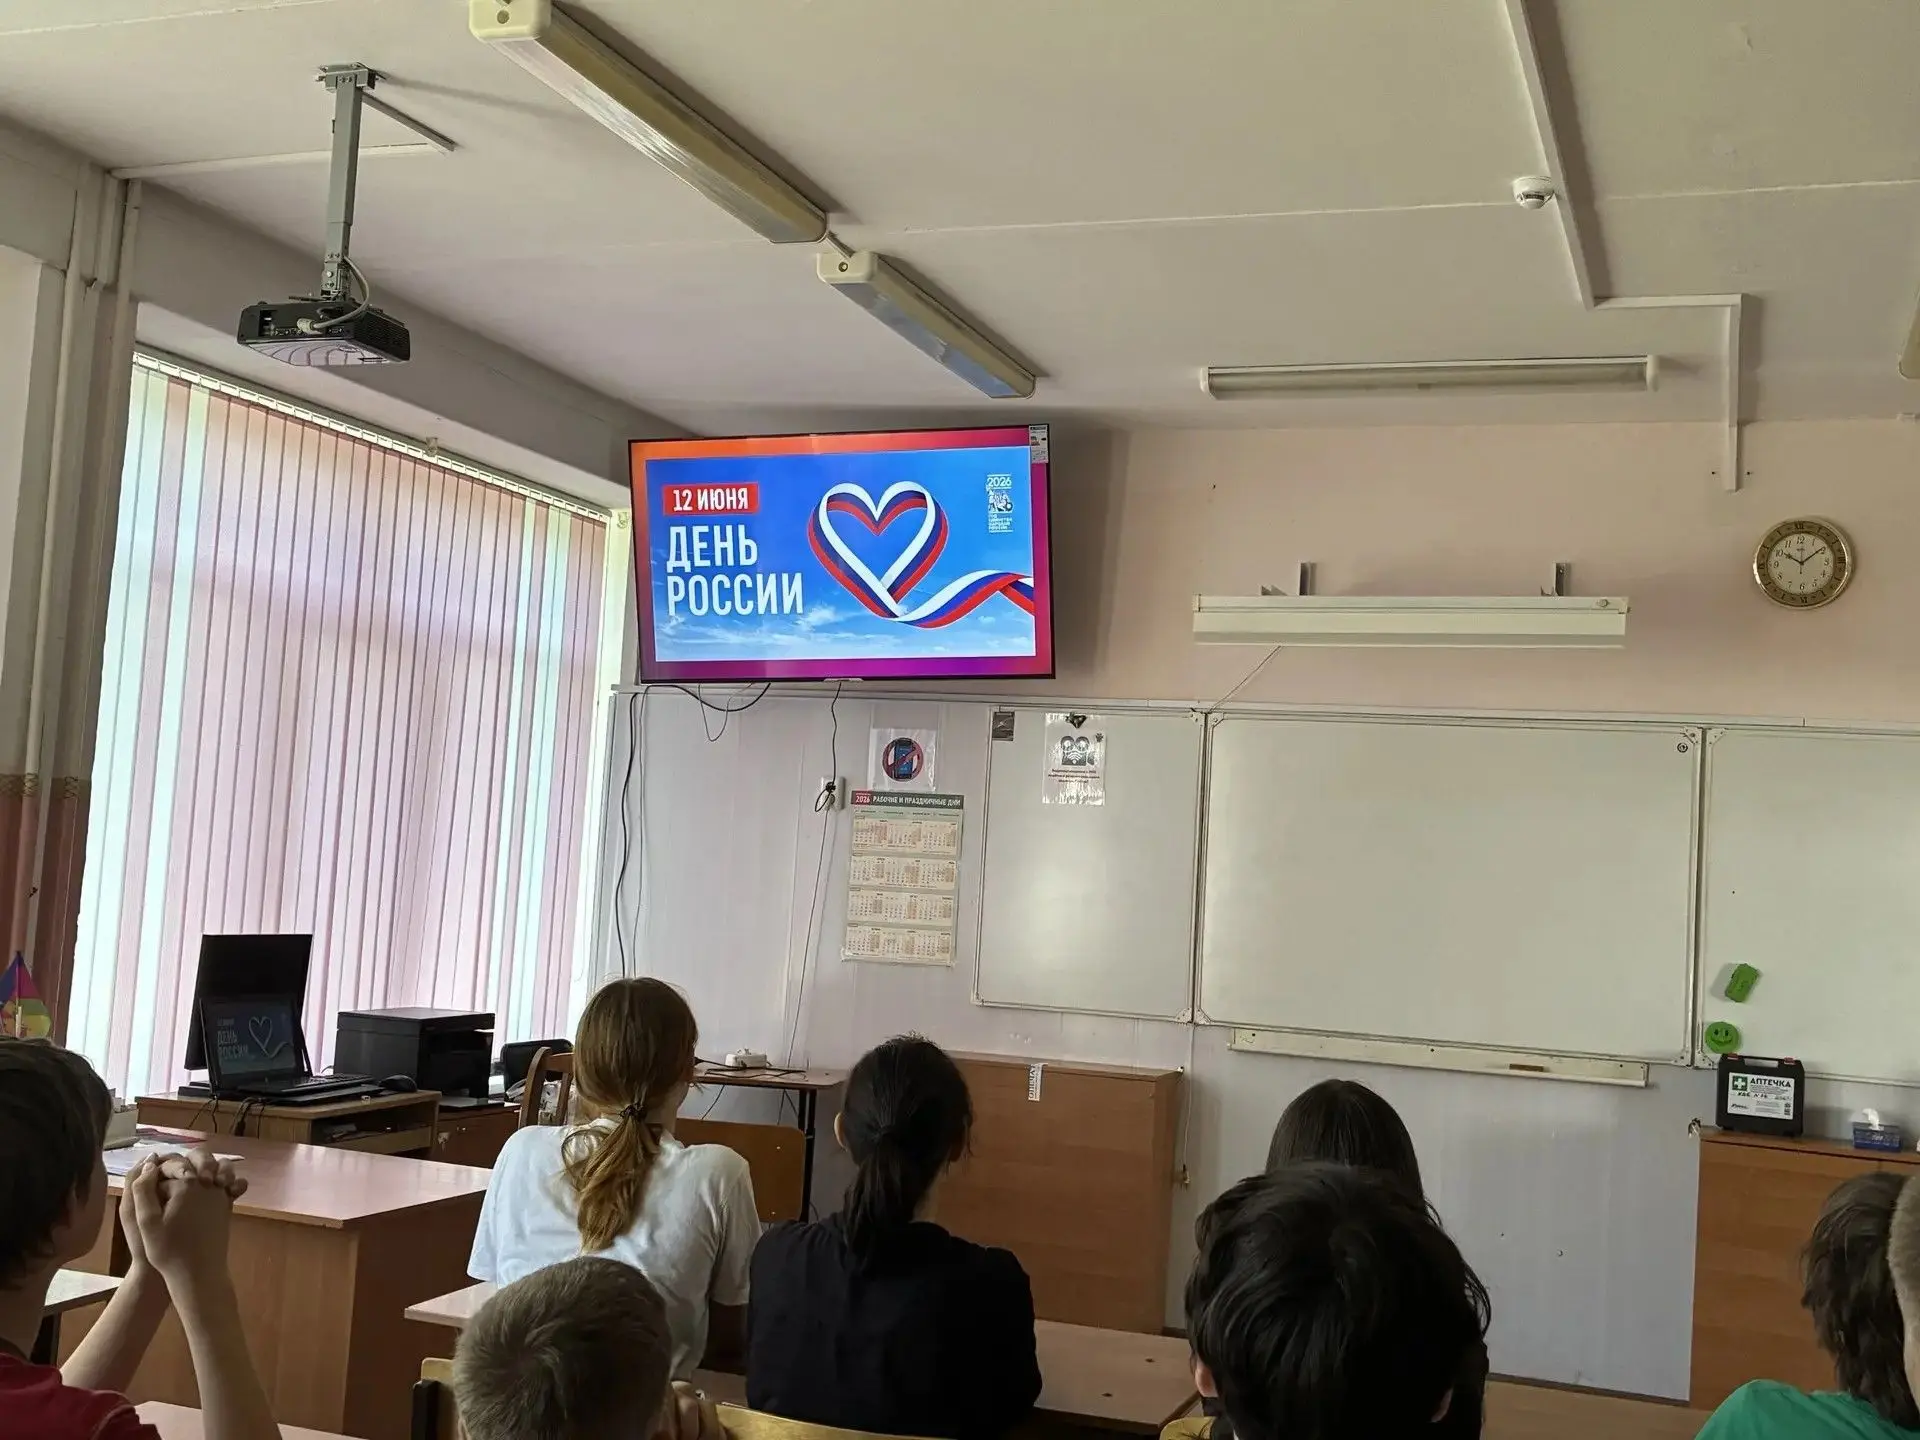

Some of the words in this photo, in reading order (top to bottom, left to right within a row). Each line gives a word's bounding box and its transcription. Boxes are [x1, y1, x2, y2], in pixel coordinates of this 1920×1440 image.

[987, 477, 1012, 487] 2026
[673, 489, 693, 511] 12
[697, 487, 748, 510] ИЮНЯ
[1784, 540, 1792, 548] 11
[1796, 536, 1805, 545] 12
[666, 524, 758, 573] ДЕНЬ
[1775, 549, 1784, 557] 10
[667, 573, 804, 616] РОССИИ
[855, 795, 871, 804] 2026
[873, 796, 898, 804] РАБОЧИЕ
[905, 797, 947, 806] ПРАЗДНИЧНЫЕ
[947, 799, 961, 807] ДНИ
[217, 1030, 237, 1046] ДЕНЬ
[1750, 1077, 1791, 1088] АПТЕЧКА
